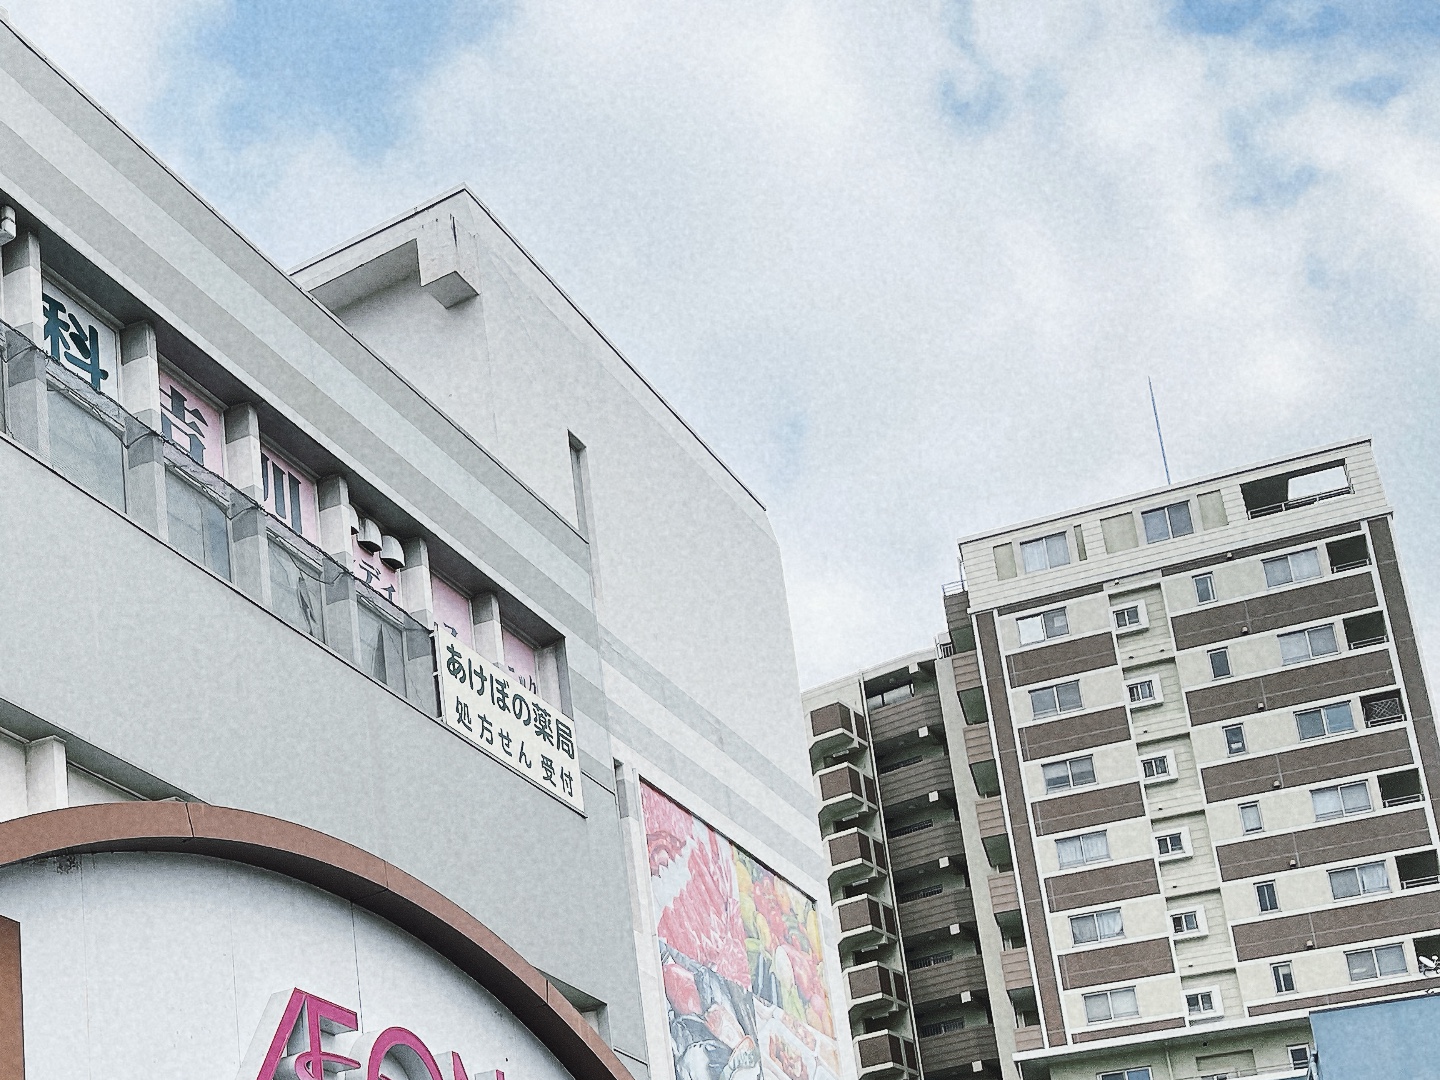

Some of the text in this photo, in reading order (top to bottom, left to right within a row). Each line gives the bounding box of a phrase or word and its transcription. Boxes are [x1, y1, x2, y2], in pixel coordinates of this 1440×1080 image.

[446, 643, 575, 760] あけぼの薬局
